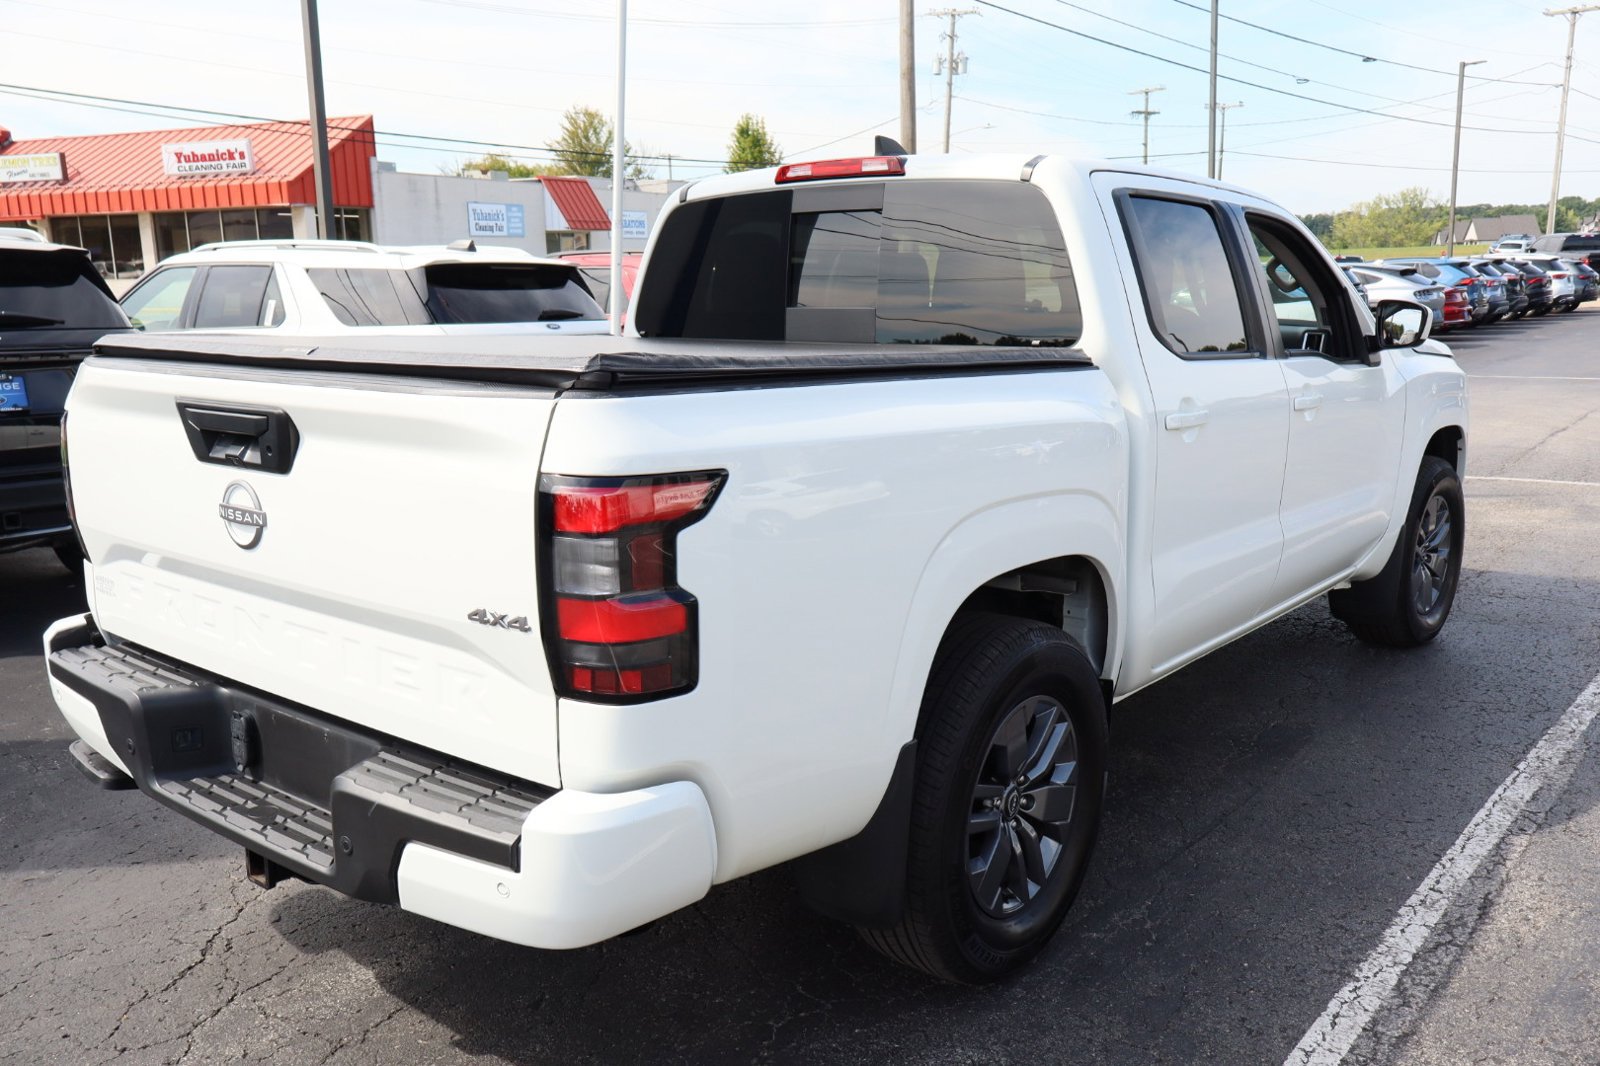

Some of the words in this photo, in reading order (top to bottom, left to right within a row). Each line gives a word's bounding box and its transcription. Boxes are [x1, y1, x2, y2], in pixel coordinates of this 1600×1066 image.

[174, 148, 246, 164] Yuhanick's
[177, 163, 223, 172] CLEANING
[220, 506, 263, 525] NISSAN
[118, 570, 497, 725] FRONTIER
